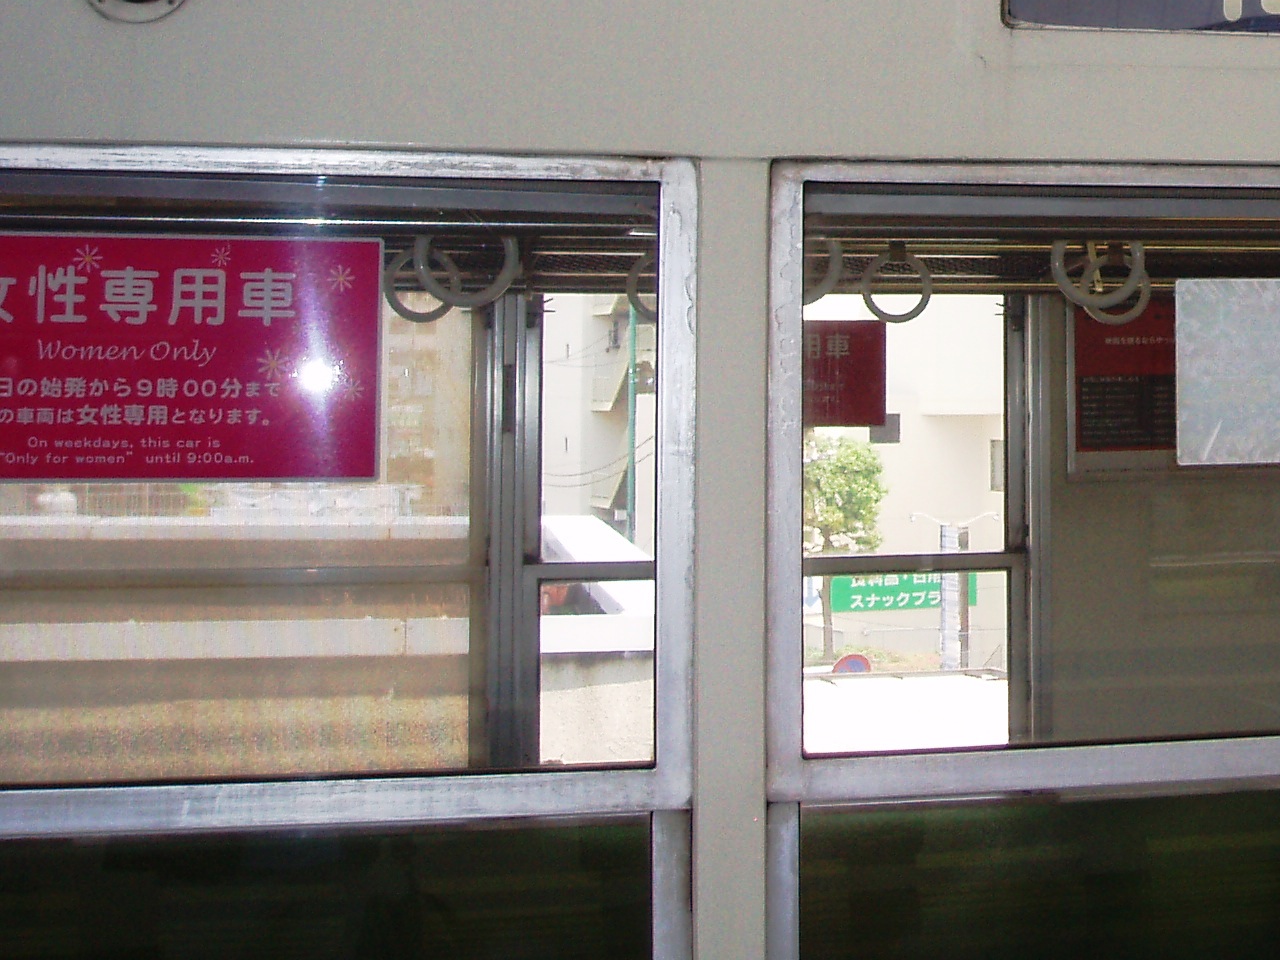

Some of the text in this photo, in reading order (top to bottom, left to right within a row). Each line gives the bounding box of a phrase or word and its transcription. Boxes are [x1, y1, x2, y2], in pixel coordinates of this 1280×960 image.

[38, 339, 217, 367] Women Only
[27, 436, 221, 449] On weekdays, this car is
[46, 452, 68, 464] for
[145, 452, 180, 463] until
[187, 452, 254, 464] 9:00a.m.
